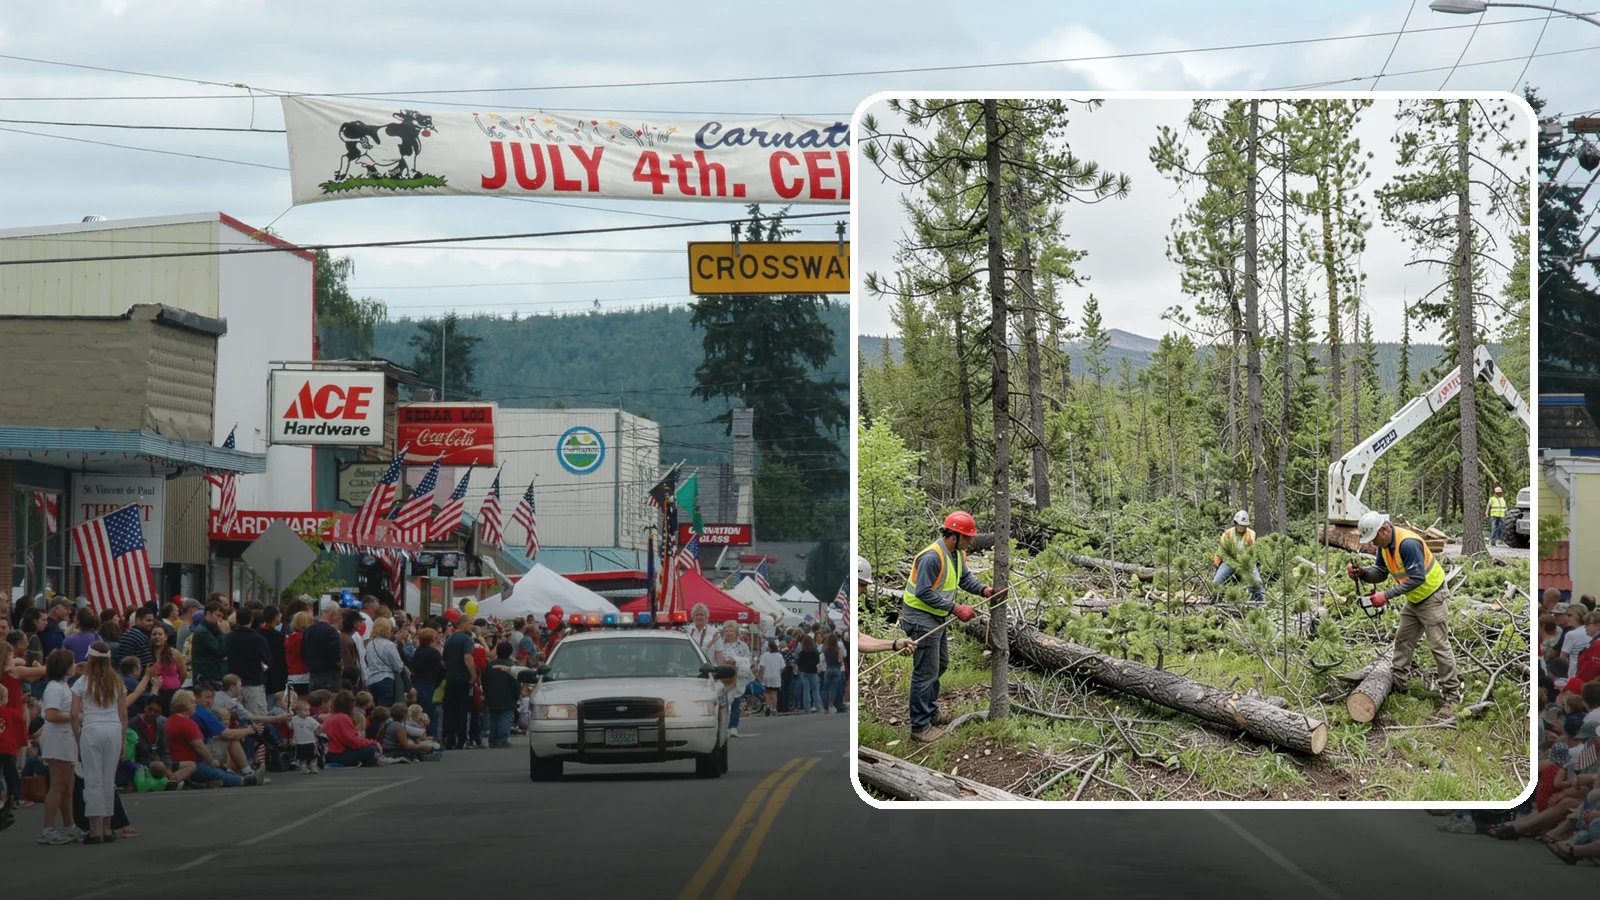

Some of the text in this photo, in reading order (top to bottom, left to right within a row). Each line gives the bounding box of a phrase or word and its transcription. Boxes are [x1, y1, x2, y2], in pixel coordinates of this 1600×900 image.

[695, 121, 850, 150] Carnat
[481, 140, 605, 193] JULY
[632, 150, 746, 198] 4th.
[697, 254, 850, 280] CROSSWA
[282, 380, 374, 420] ACE
[406, 409, 453, 422] CEDAR
[283, 421, 371, 436] Hardware
[416, 428, 477, 447] Coca-Cola
[95, 484, 124, 495] Vincent
[126, 486, 136, 495] de
[138, 486, 155, 495] Paul
[688, 526, 741, 535] CRNATION
[699, 535, 730, 543] GLASS
